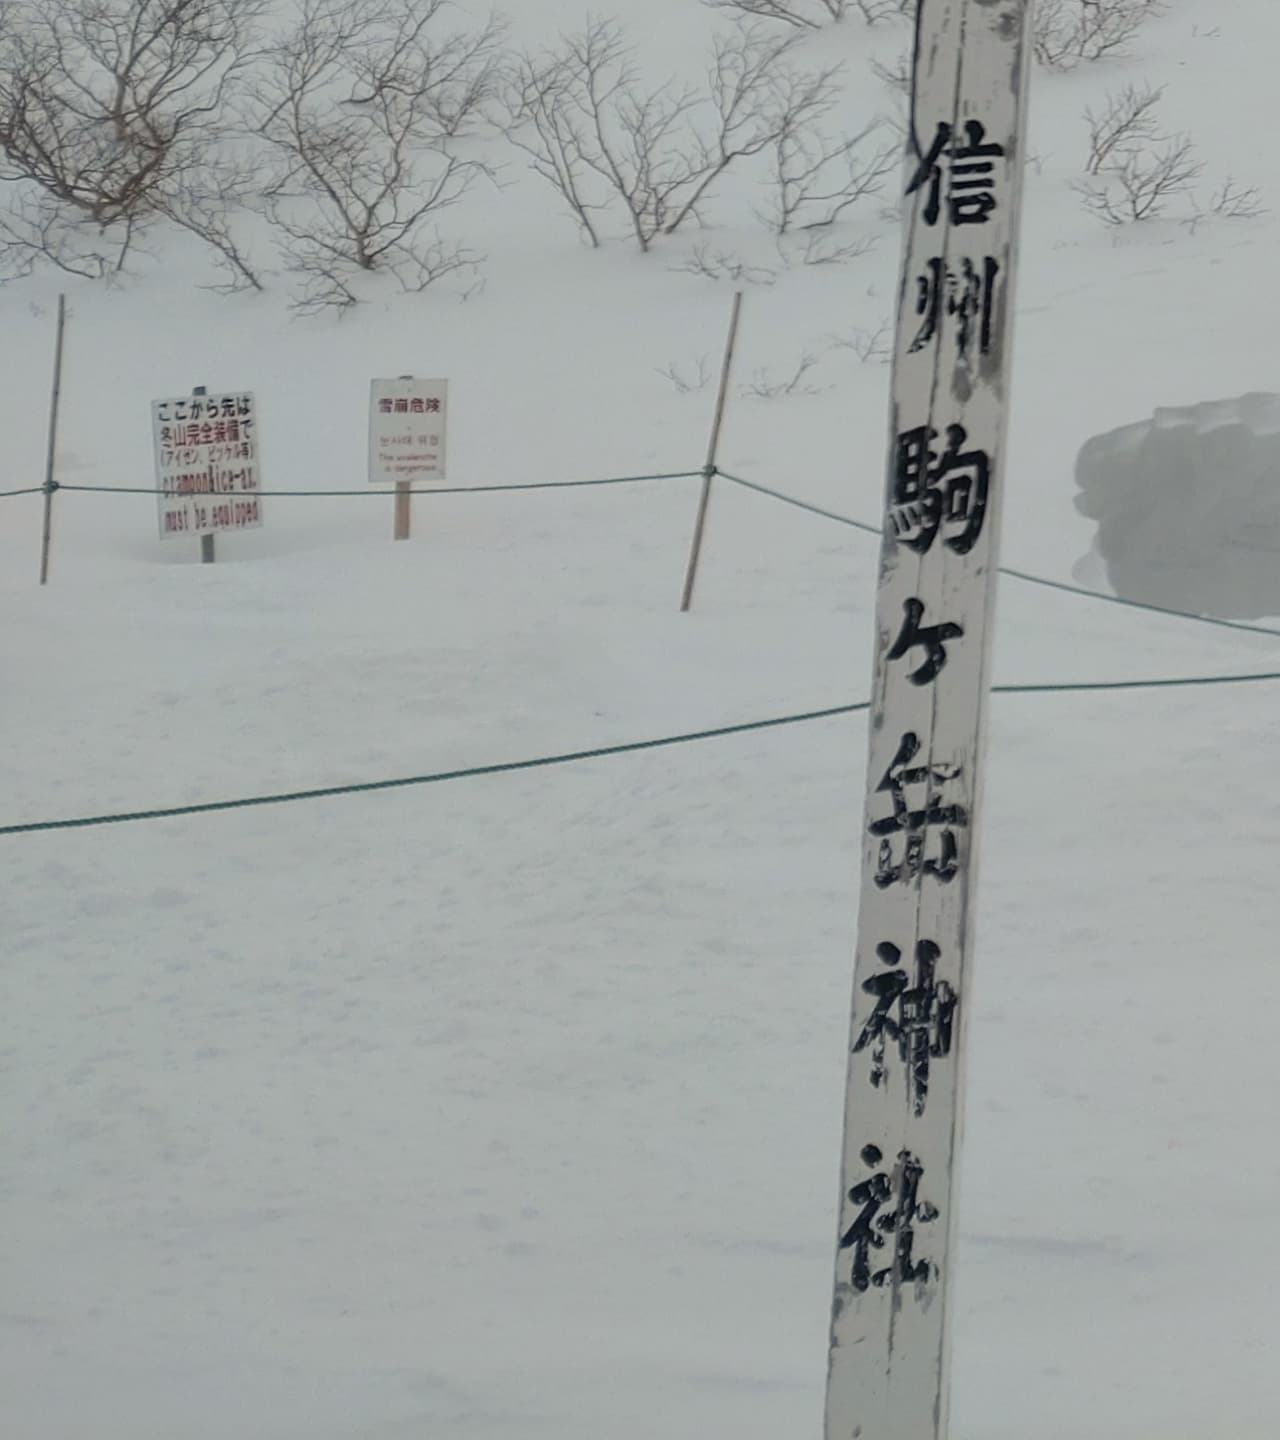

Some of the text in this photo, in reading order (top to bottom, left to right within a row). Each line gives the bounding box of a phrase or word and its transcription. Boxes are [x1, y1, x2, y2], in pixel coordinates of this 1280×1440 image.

[158, 396, 251, 421] ここから先は
[378, 398, 440, 413] 雪崩危険
[160, 419, 254, 447] 冬山完全装備で
[194, 501, 207, 530] be
